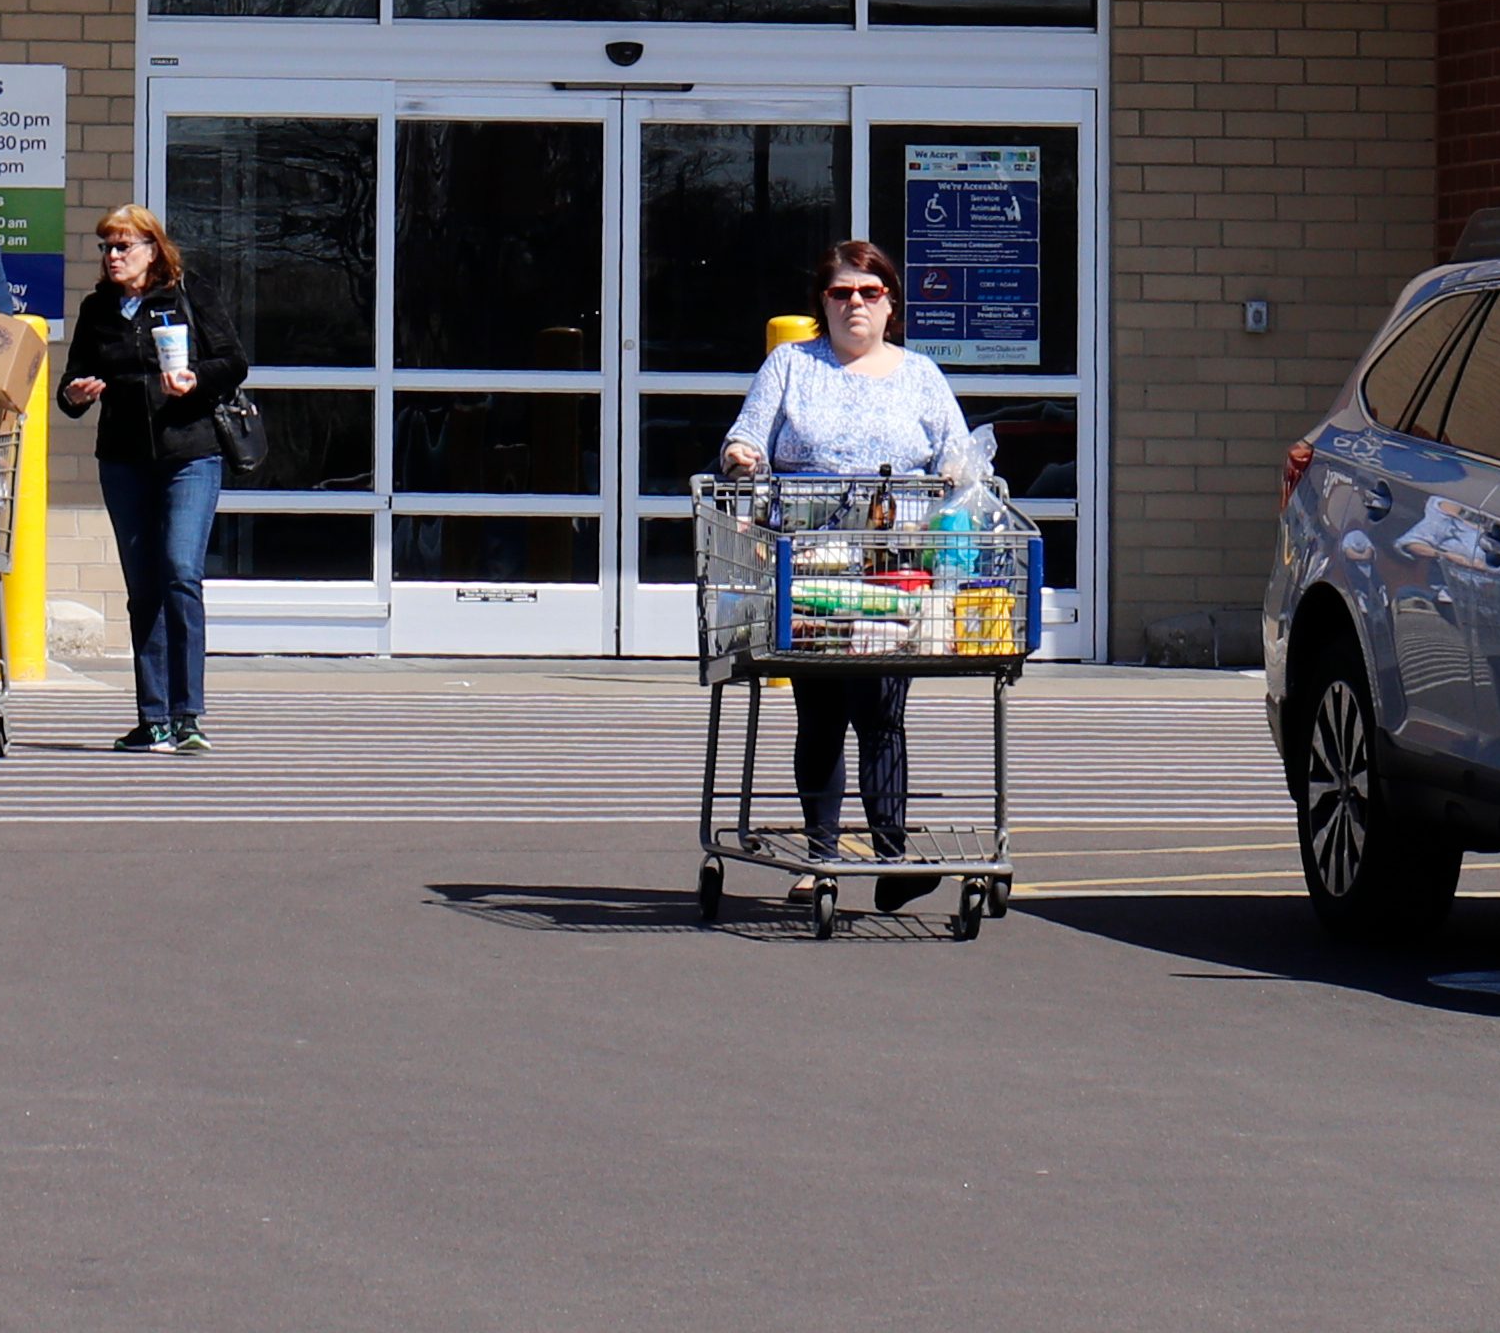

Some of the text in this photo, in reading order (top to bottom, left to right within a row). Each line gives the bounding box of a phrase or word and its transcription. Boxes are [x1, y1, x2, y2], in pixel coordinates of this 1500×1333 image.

[23, 114, 50, 130] pm
[19, 138, 47, 153] pm
[7, 220, 28, 229] am
[8, 237, 28, 246] am
[925, 345, 952, 356] WiFi
